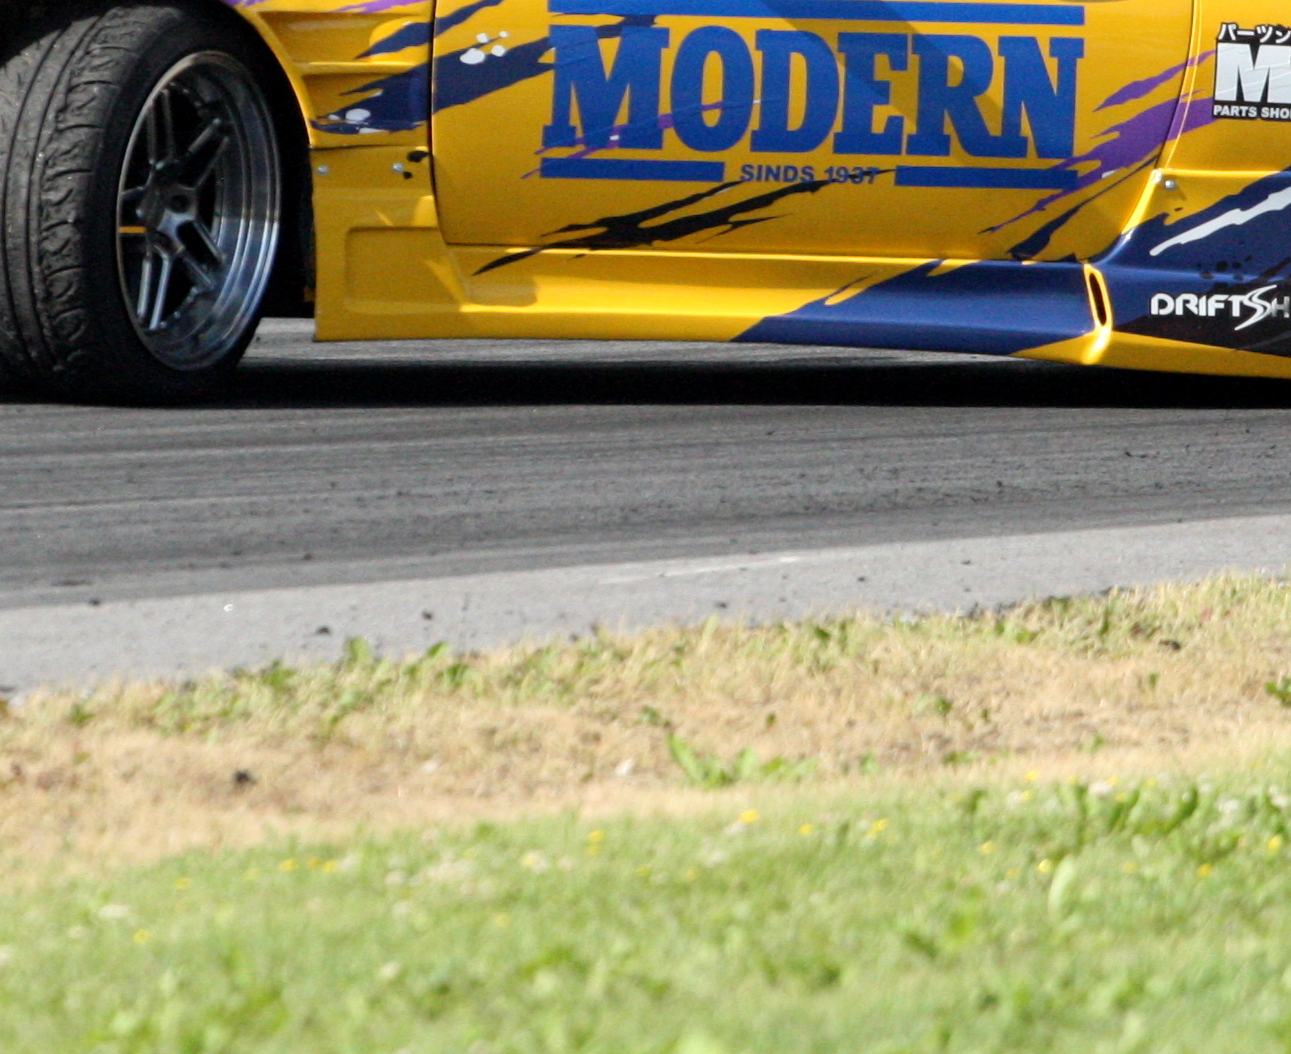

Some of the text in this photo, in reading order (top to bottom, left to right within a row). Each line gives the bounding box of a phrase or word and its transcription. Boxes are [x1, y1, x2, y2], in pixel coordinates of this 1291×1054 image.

[541, 24, 1085, 160] MODERN
[1213, 105, 1257, 118] PARTS
[740, 164, 880, 185] SINDS 1937
